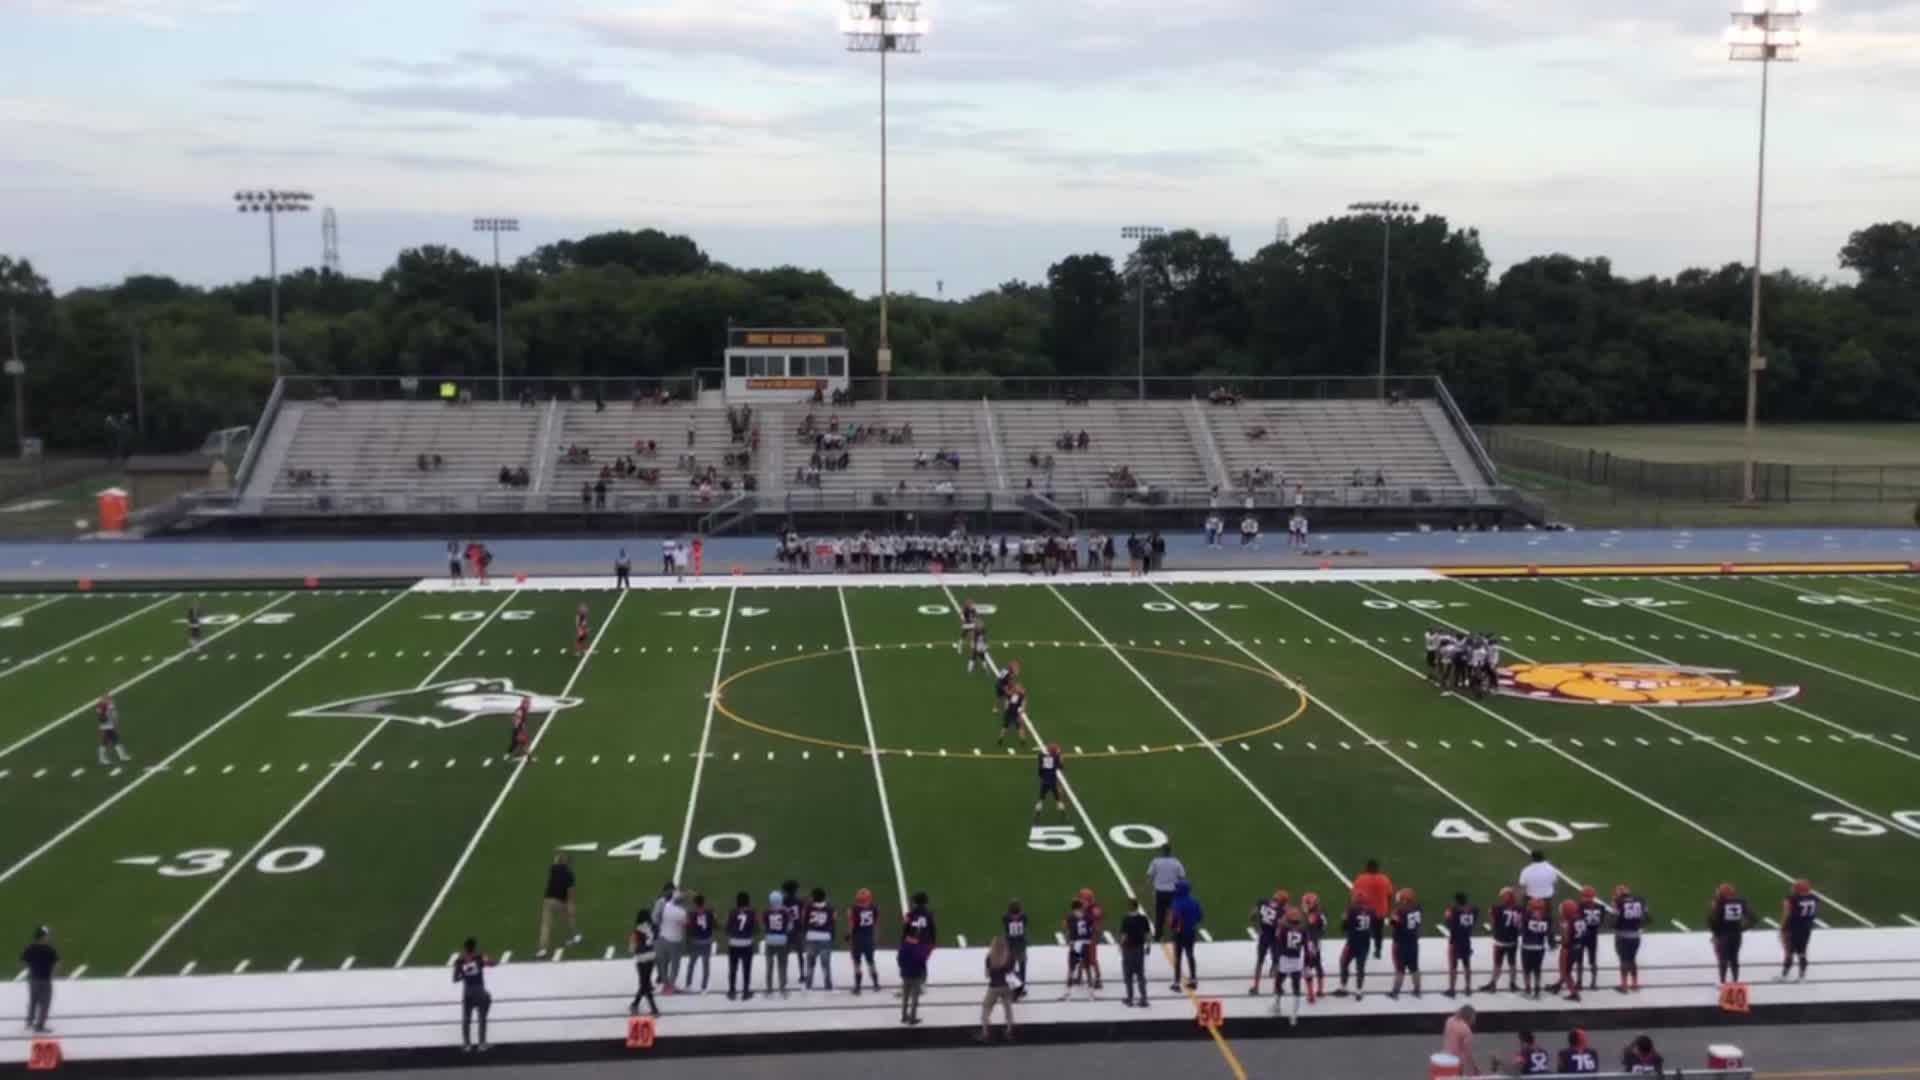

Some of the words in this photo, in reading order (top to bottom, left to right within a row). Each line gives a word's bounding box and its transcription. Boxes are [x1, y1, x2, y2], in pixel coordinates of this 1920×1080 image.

[1027, 824, 1169, 852] 50
[1431, 817, 1573, 843] 40
[607, 832, 757, 861] 40
[157, 845, 325, 877] 30
[737, 913, 748, 931] 7
[1724, 986, 1748, 1009] 40
[1200, 1001, 1221, 1023] 50
[631, 1021, 651, 1044] 40
